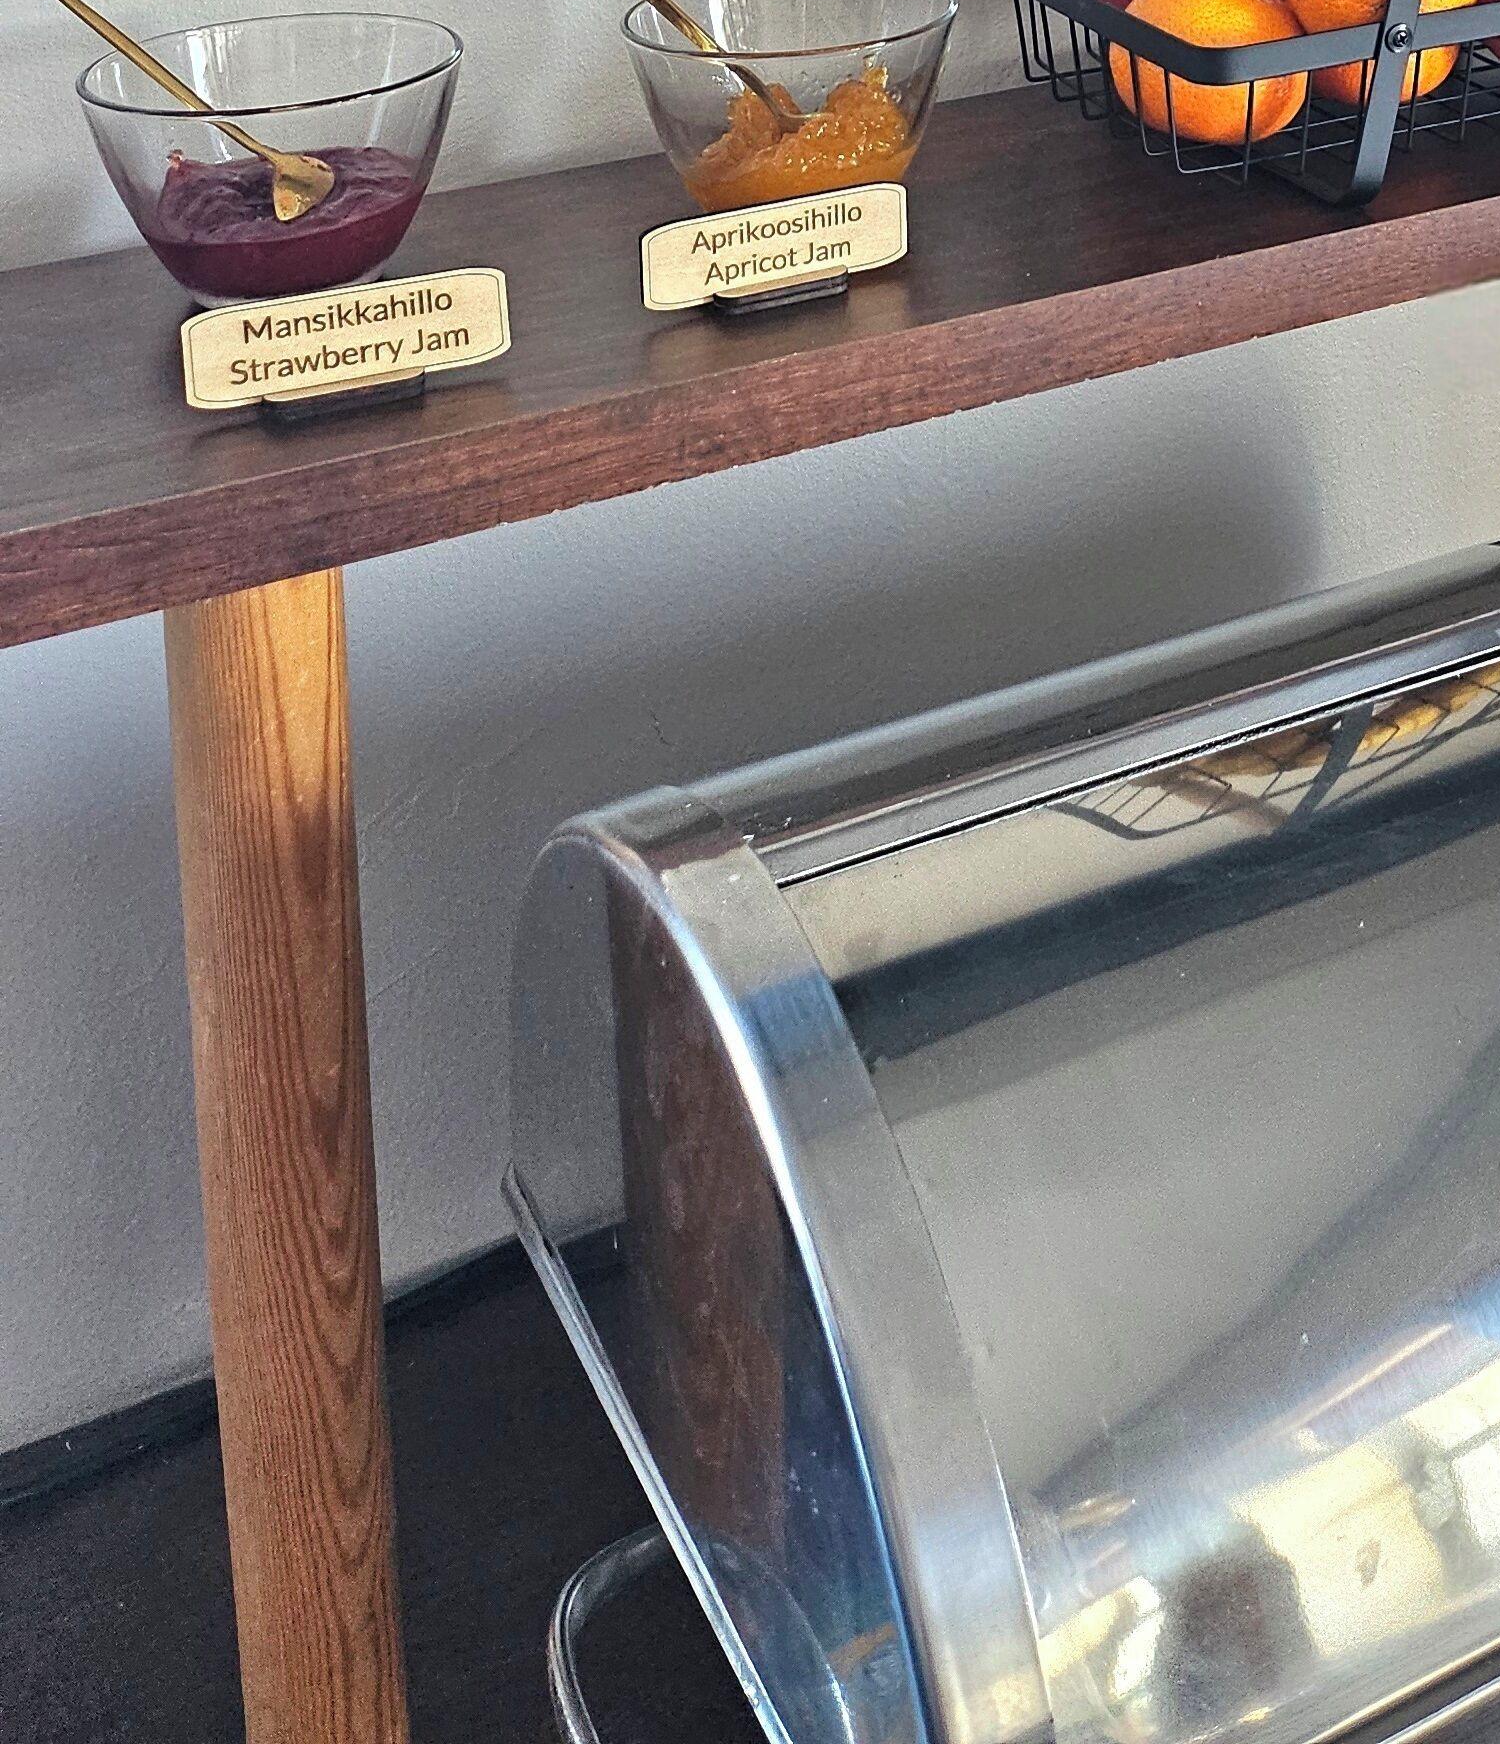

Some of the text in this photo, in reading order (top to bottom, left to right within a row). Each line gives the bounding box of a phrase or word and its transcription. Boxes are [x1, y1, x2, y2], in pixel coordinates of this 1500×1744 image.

[690, 200, 863, 255] Aprikoosihillo
[704, 237, 853, 288] Apricot Jam
[242, 287, 453, 344] Mansikkahillo
[230, 325, 470, 386] Strawberry Jam
